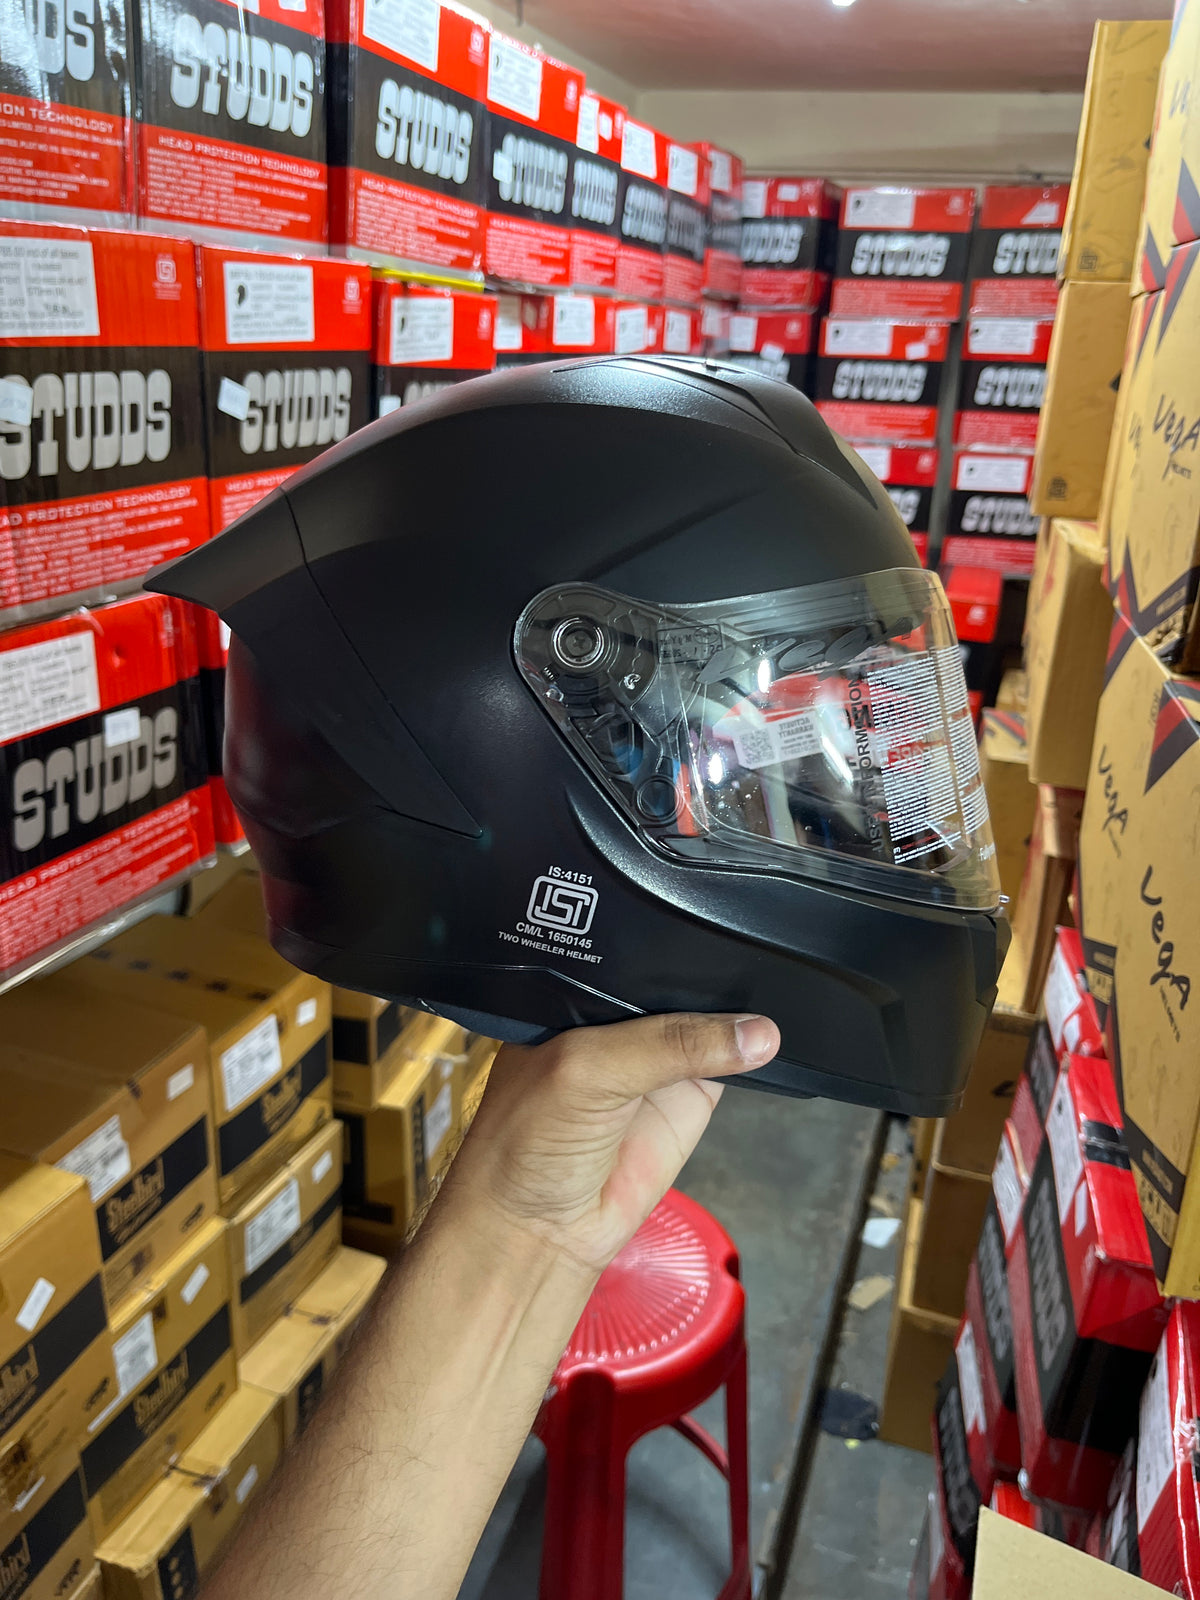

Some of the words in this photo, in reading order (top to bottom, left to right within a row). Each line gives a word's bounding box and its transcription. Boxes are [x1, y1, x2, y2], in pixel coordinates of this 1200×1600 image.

[169, 13, 315, 138] STUDDS
[29, 106, 115, 134] TECHNOLOGY
[375, 77, 474, 185] STUDDS
[850, 232, 951, 278] STUDDS
[993, 231, 1060, 276] STUD
[831, 359, 929, 404] STUDDS
[239, 367, 353, 455] STUDDS
[26, 499, 114, 524] PROTECTION
[115, 485, 192, 509] TECHNOLOGY
[13, 706, 178, 852] STUDDS
[40, 836, 122, 882] PROTECTION
[547, 865, 593, 886] IS:4151
[498, 930, 520, 944] TWO
[520, 937, 565, 957] WHEELER
[565, 948, 604, 965] HELMET
[515, 921, 545, 939] CM/L
[546, 930, 593, 950] 1650145
